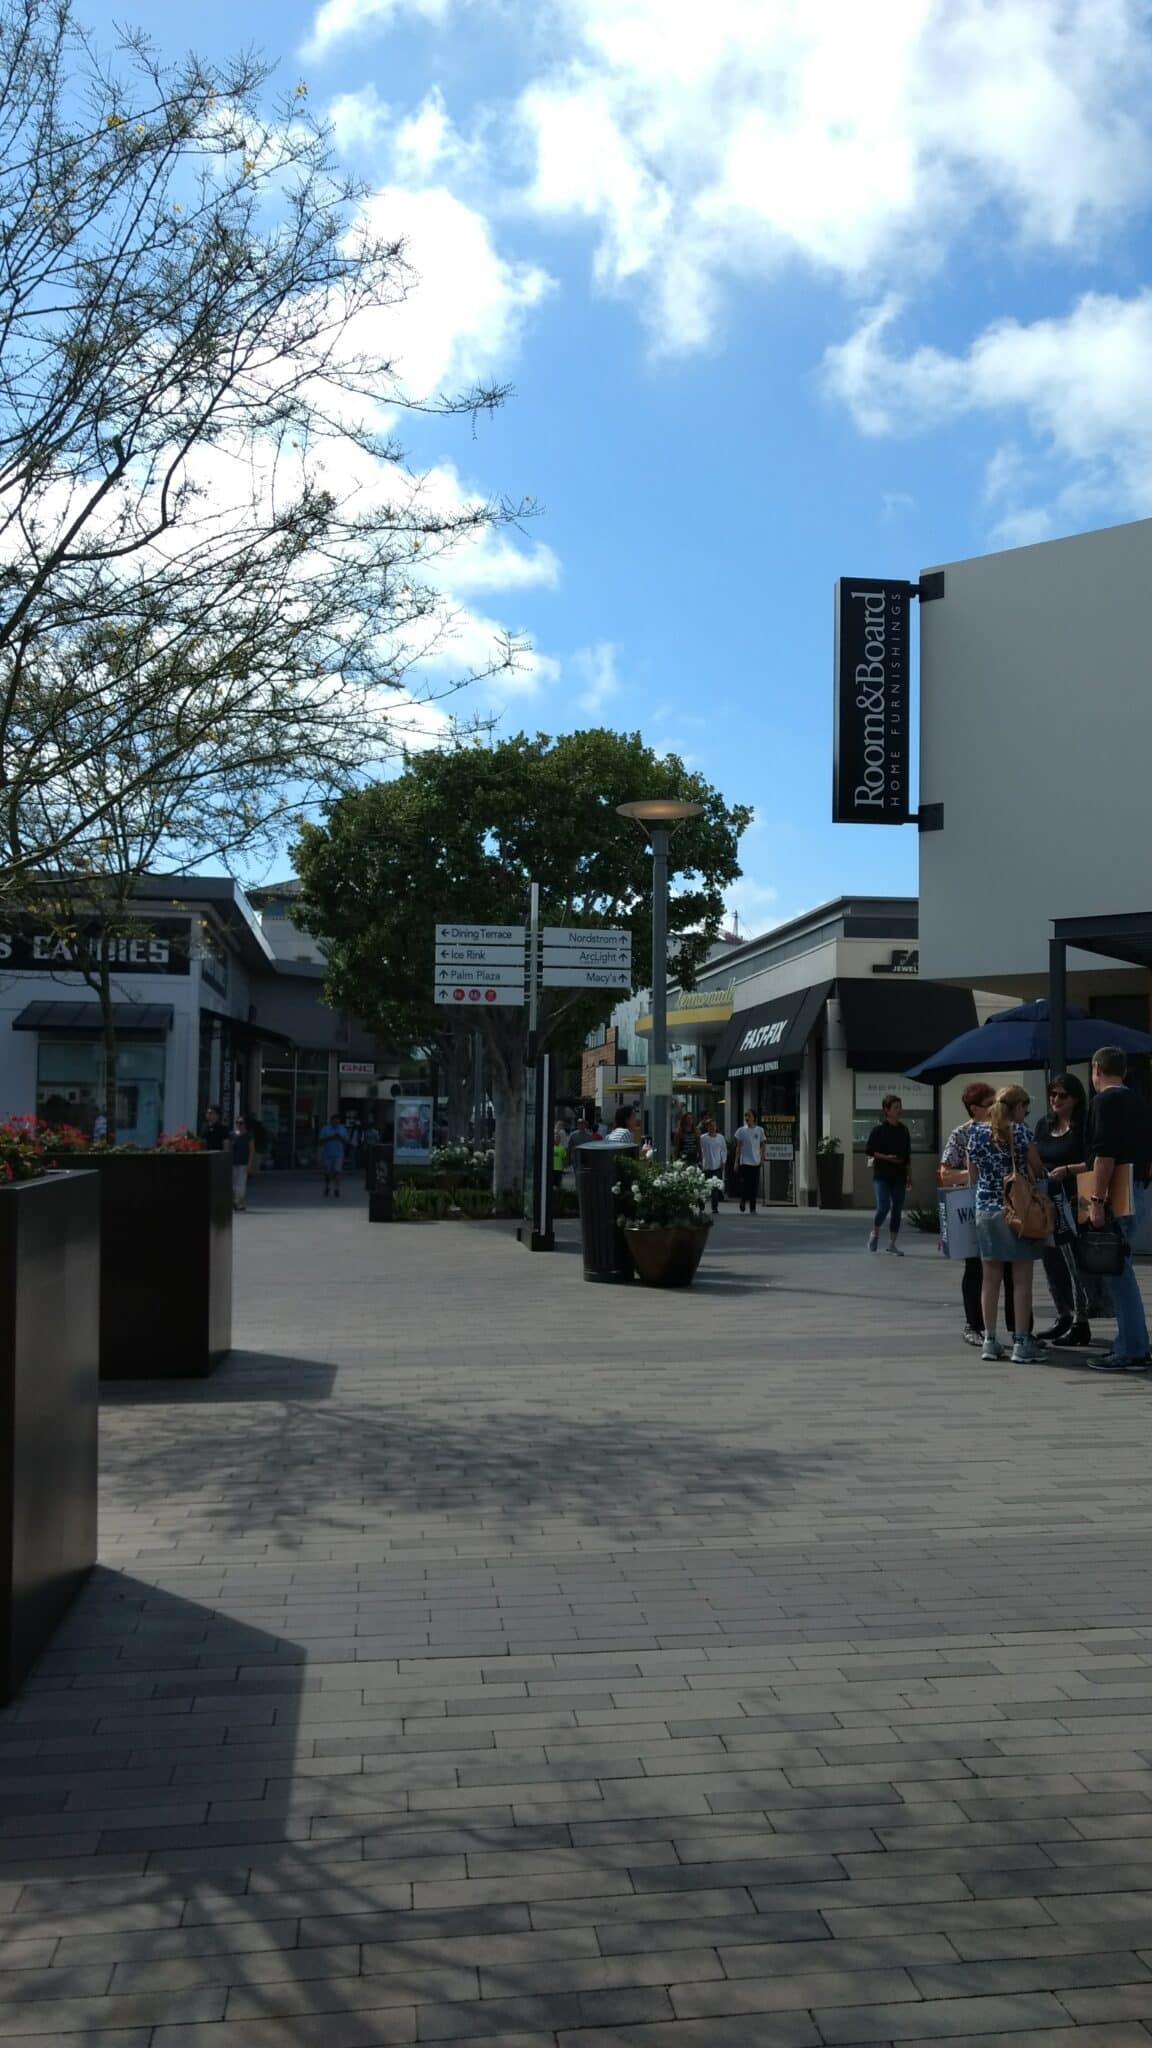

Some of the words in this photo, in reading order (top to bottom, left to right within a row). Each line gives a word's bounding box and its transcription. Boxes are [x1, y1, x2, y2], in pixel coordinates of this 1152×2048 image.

[890, 591, 901, 735] FURNISHINGS
[851, 589, 886, 808] Room&Board
[890, 751, 901, 806] HOME
[451, 928, 479, 940] Dining
[480, 928, 512, 939] Terrace
[569, 932, 617, 944] Nordstrom
[451, 949, 464, 959] Ice
[466, 949, 486, 960] Rink
[580, 951, 617, 963] ArcLight
[891, 949, 919, 966] FA
[450, 970, 473, 980] Palm
[477, 970, 500, 980] Plaza
[892, 965, 919, 974] JEWEL
[586, 972, 617, 984] Macy's
[678, 977, 734, 1008] lemonad
[957, 1207, 976, 1224] WA
